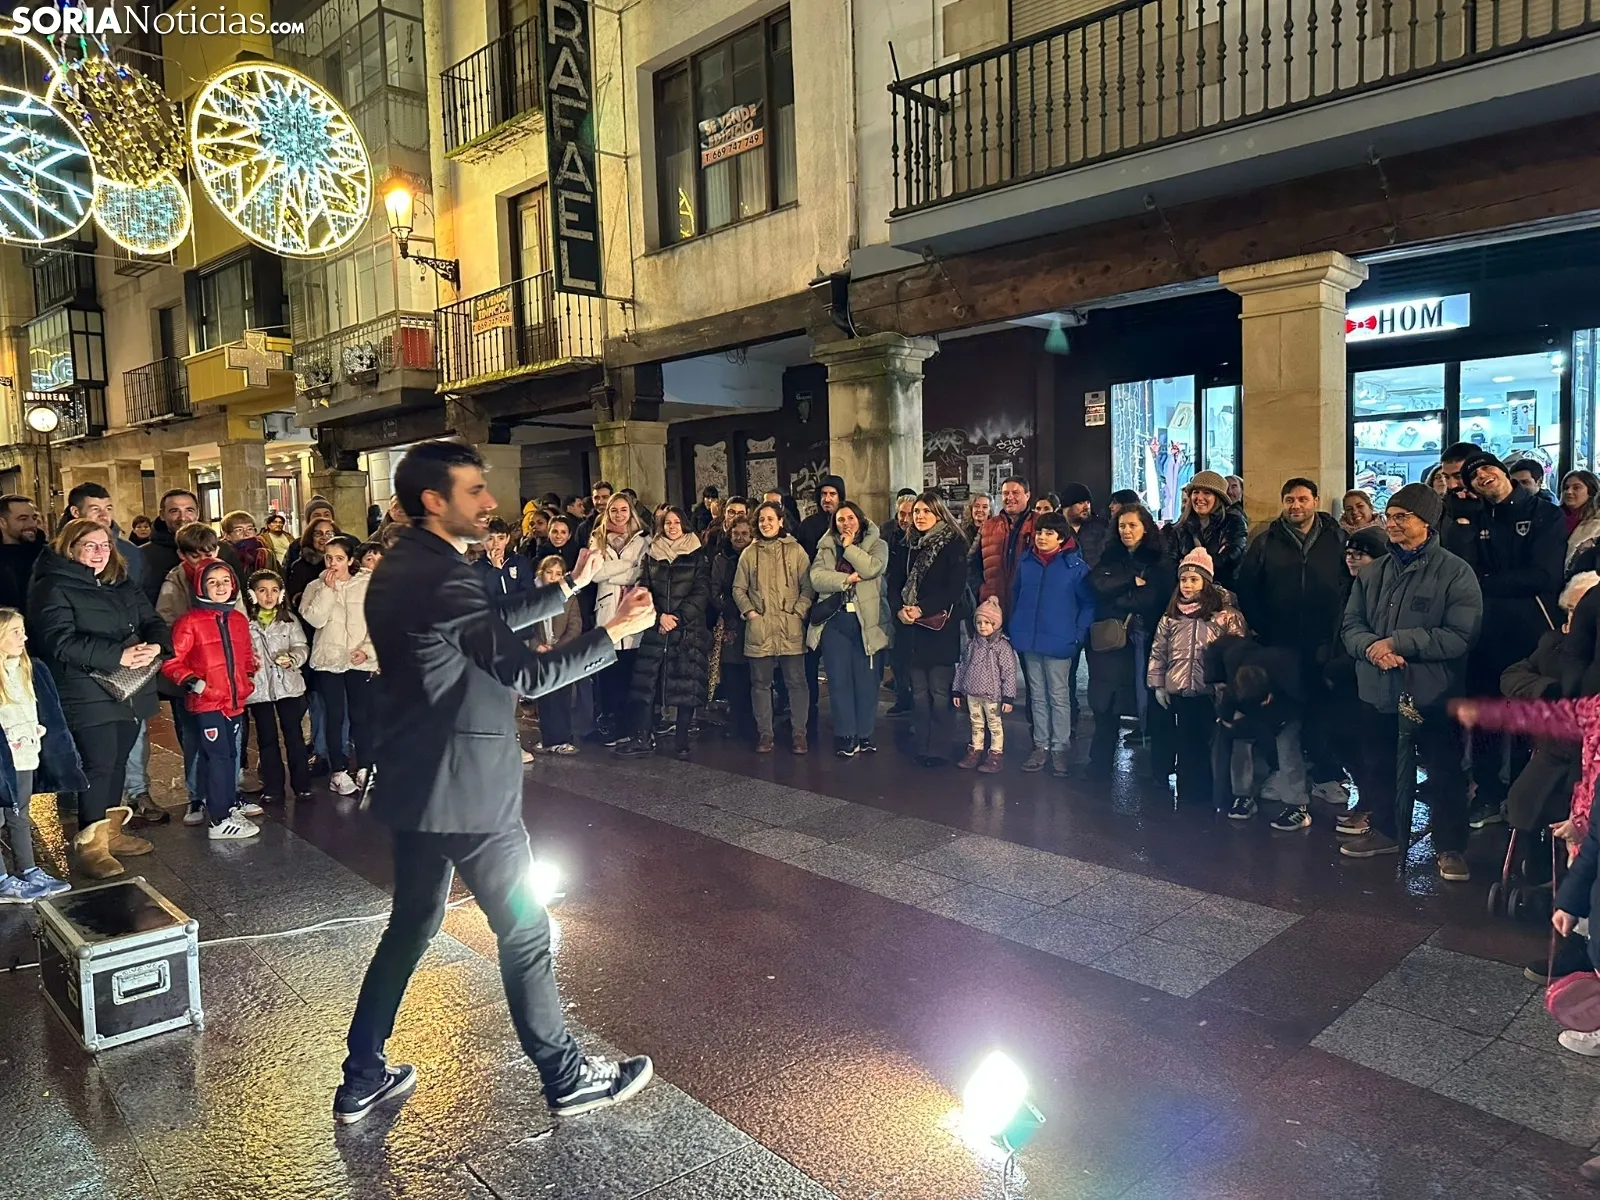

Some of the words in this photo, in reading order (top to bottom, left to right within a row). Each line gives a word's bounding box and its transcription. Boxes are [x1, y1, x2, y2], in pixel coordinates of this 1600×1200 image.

[704, 120, 717, 136] SE
[718, 103, 757, 129] VENDE
[546, 0, 597, 291] RAFAEL
[712, 147, 727, 159] 669
[728, 141, 742, 152] 747
[744, 133, 760, 147] 749
[1378, 299, 1445, 335] HOM
[26, 391, 70, 402] MONREAL
